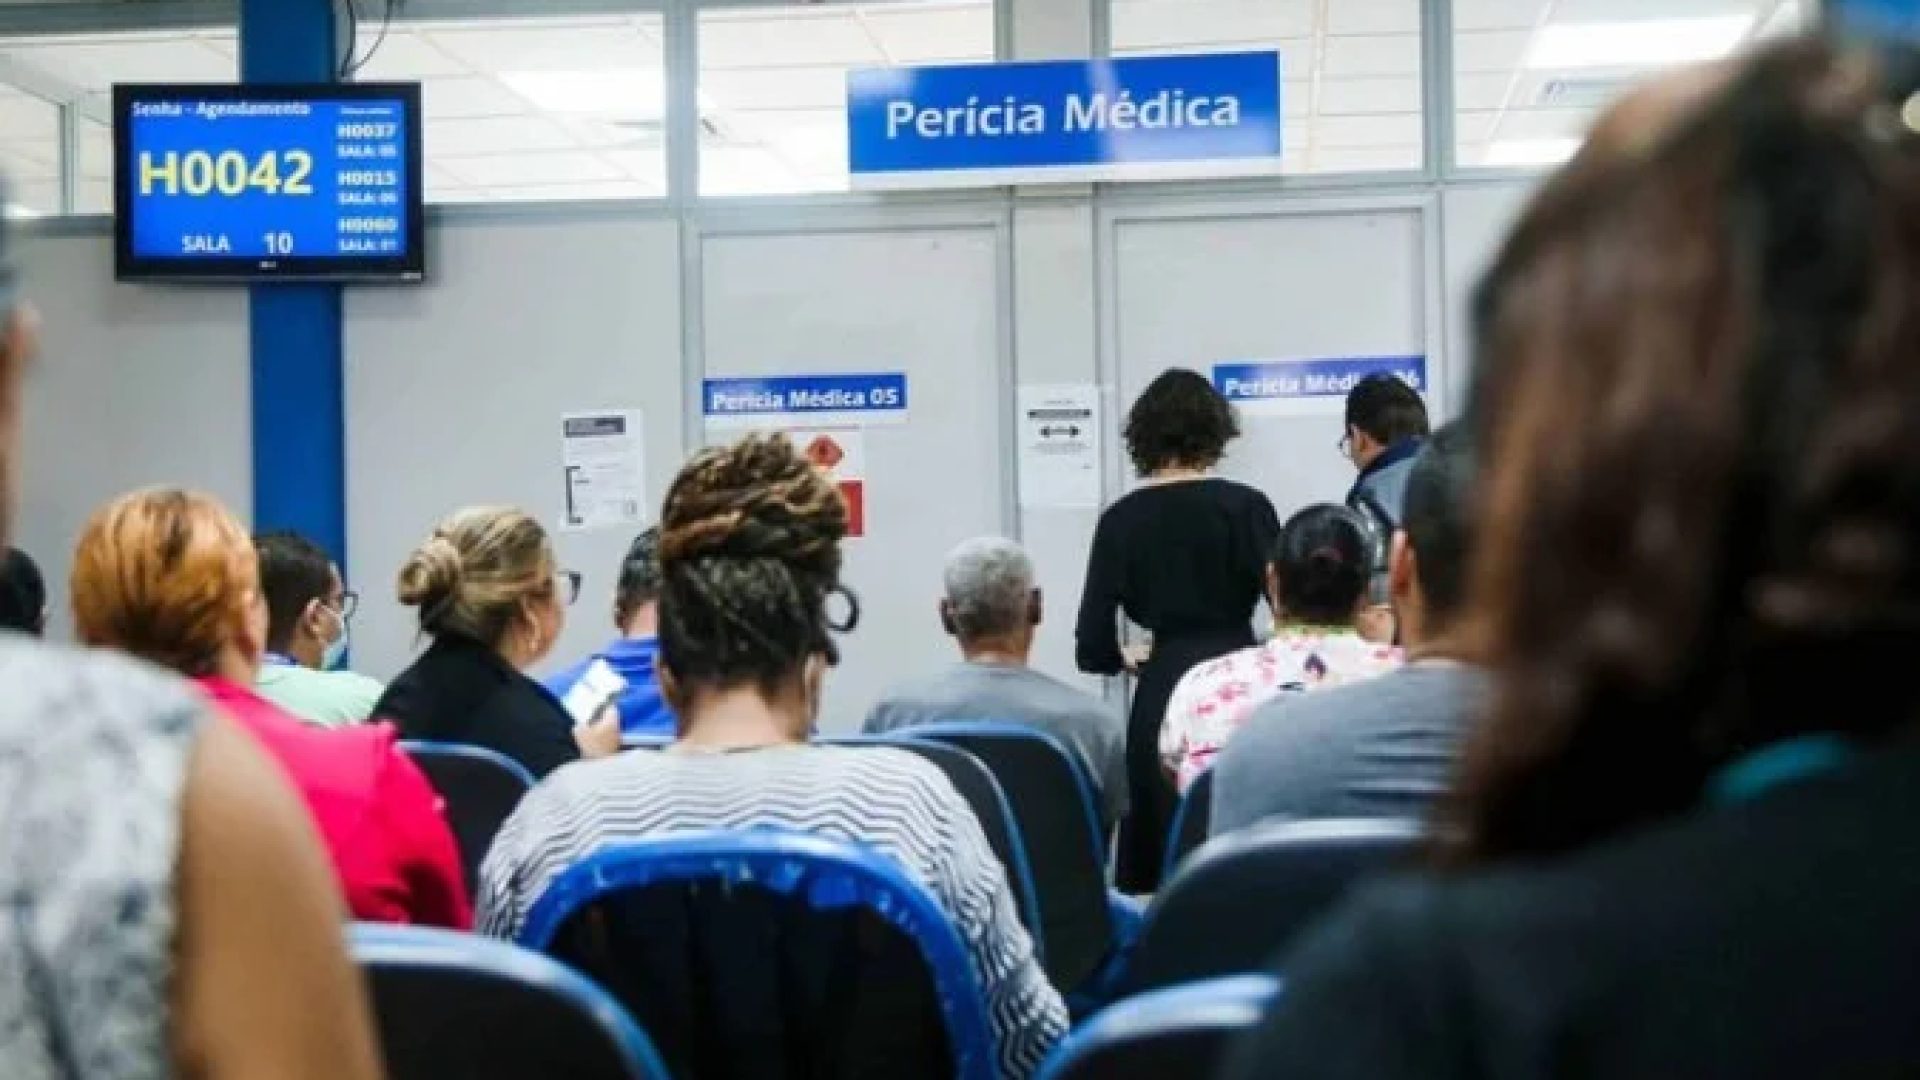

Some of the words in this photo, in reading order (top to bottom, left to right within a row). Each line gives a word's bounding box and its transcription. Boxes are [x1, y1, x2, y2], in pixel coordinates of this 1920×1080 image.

[131, 101, 182, 117] Senha
[195, 101, 311, 120] Agendamento
[886, 95, 1045, 139] Perícia
[1063, 87, 1240, 132] Médica
[138, 150, 314, 195] H0042
[181, 235, 231, 253] SALA
[263, 232, 294, 253] 10
[1305, 371, 1362, 391] Médi
[789, 387, 865, 408] Médica
[870, 386, 899, 405] 05
